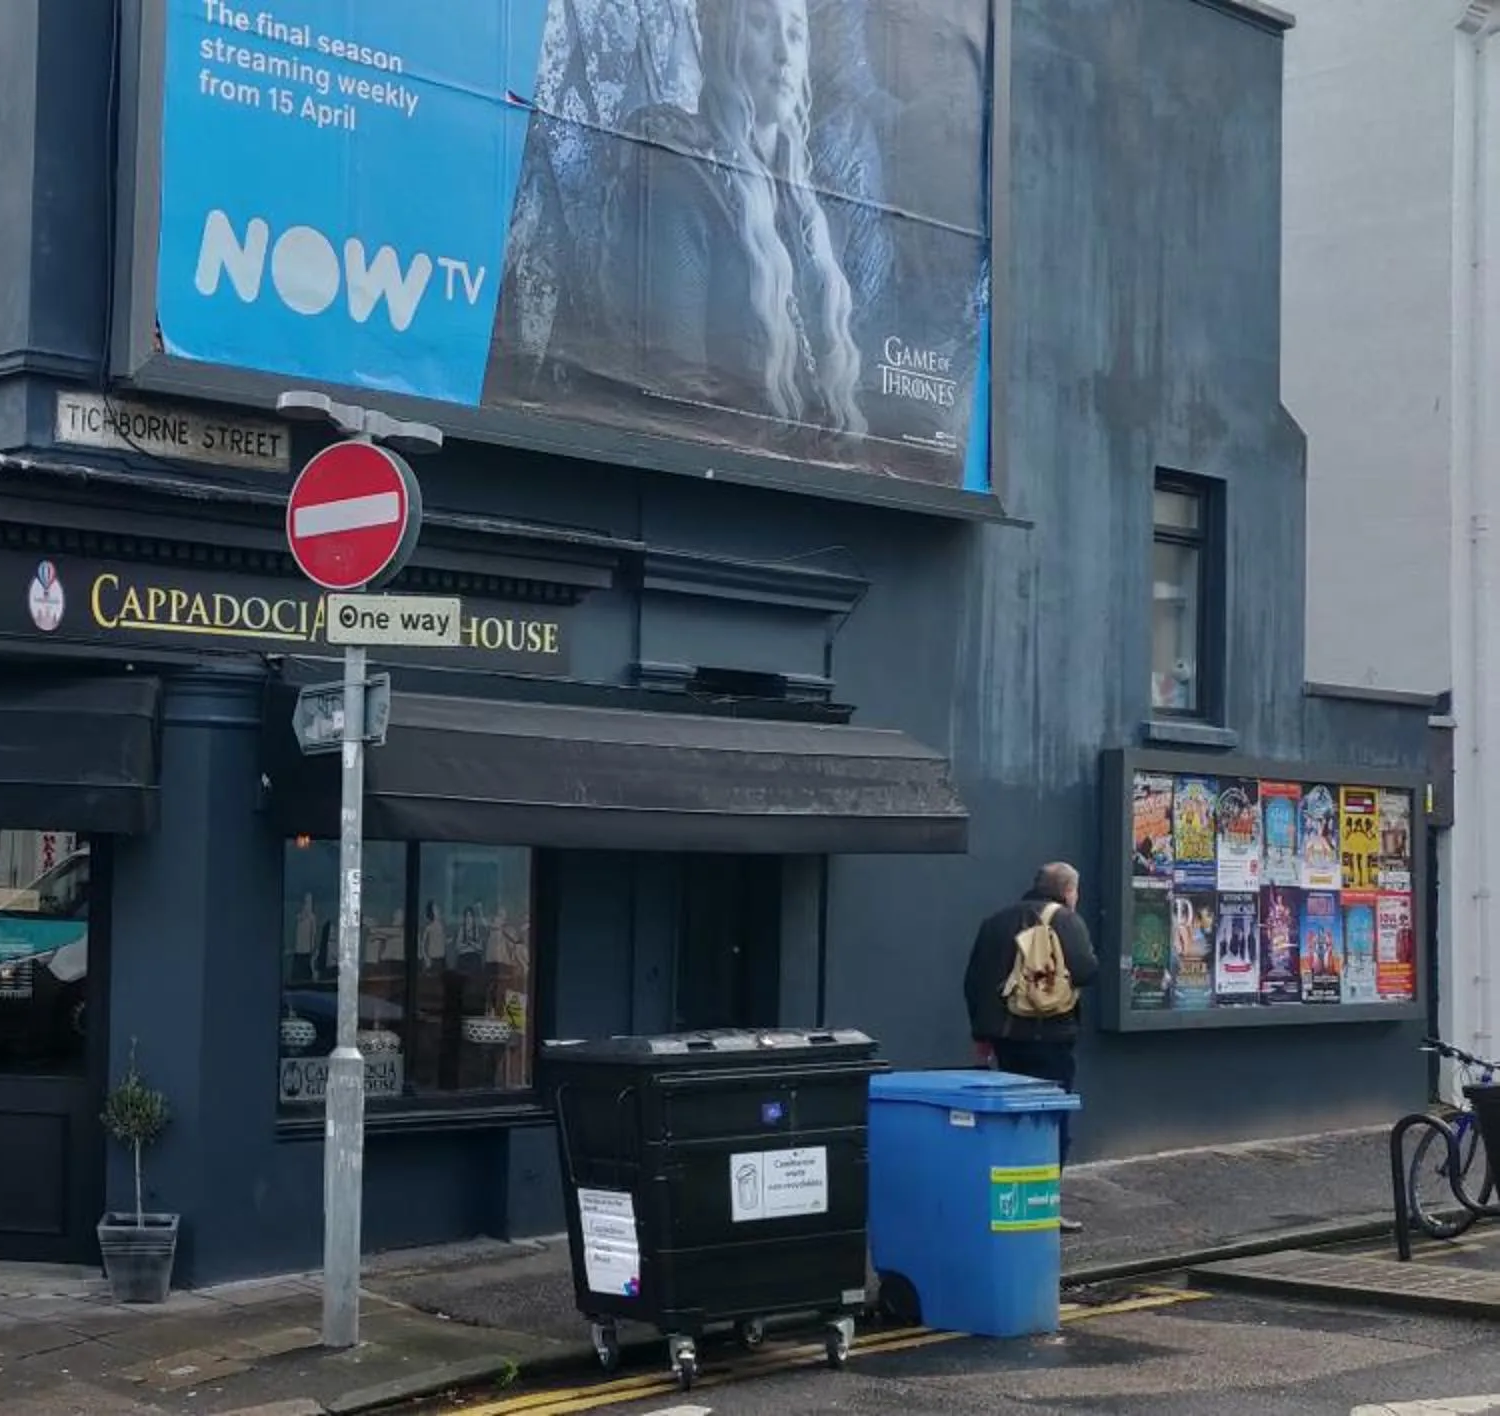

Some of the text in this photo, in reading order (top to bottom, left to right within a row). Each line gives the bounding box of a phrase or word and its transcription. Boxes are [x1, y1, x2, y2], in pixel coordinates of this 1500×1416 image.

[205, 0, 403, 73] The final season
[199, 37, 420, 118] streaming weekly
[199, 70, 357, 131] from 15 April
[195, 208, 486, 332] NOW TV
[884, 335, 938, 372] GAME
[877, 363, 957, 406] THRONES
[67, 402, 283, 457] TICHBORNE STREET
[339, 604, 450, 636] One way
[460, 617, 560, 654] HOUSE
